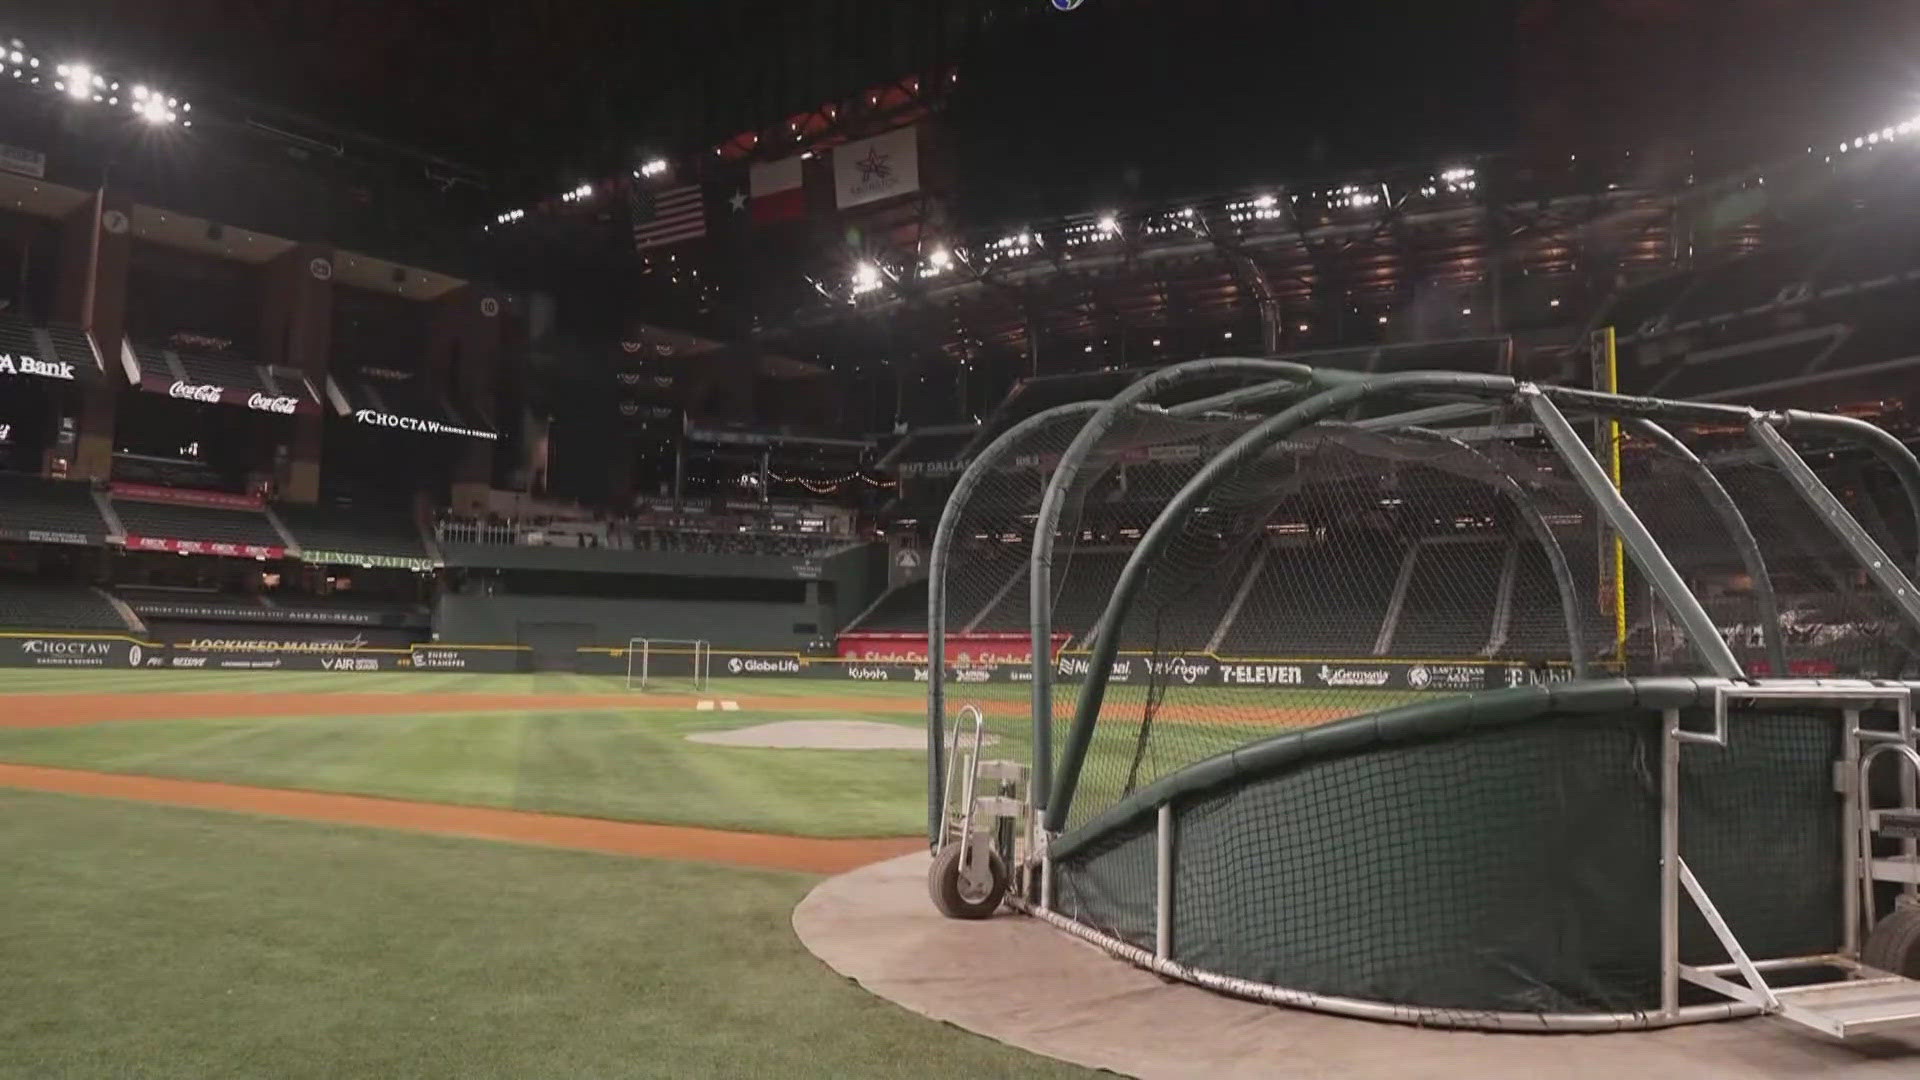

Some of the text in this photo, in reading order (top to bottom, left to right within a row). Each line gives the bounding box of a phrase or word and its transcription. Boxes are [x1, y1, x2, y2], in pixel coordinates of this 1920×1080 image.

[19, 355, 75, 380] Bank
[169, 380, 224, 403] Coca-Cola
[248, 392, 299, 415] Coca-Cola
[364, 410, 440, 433] CHOCTAW
[32, 641, 111, 654] CHOCTAW
[190, 639, 345, 655] LOCKHEED MARTIN
[428, 651, 458, 659] ENERGY
[335, 658, 354, 670] AIR
[745, 659, 778, 672] Globe
[779, 660, 800, 673] Life
[849, 667, 888, 680] Kubota
